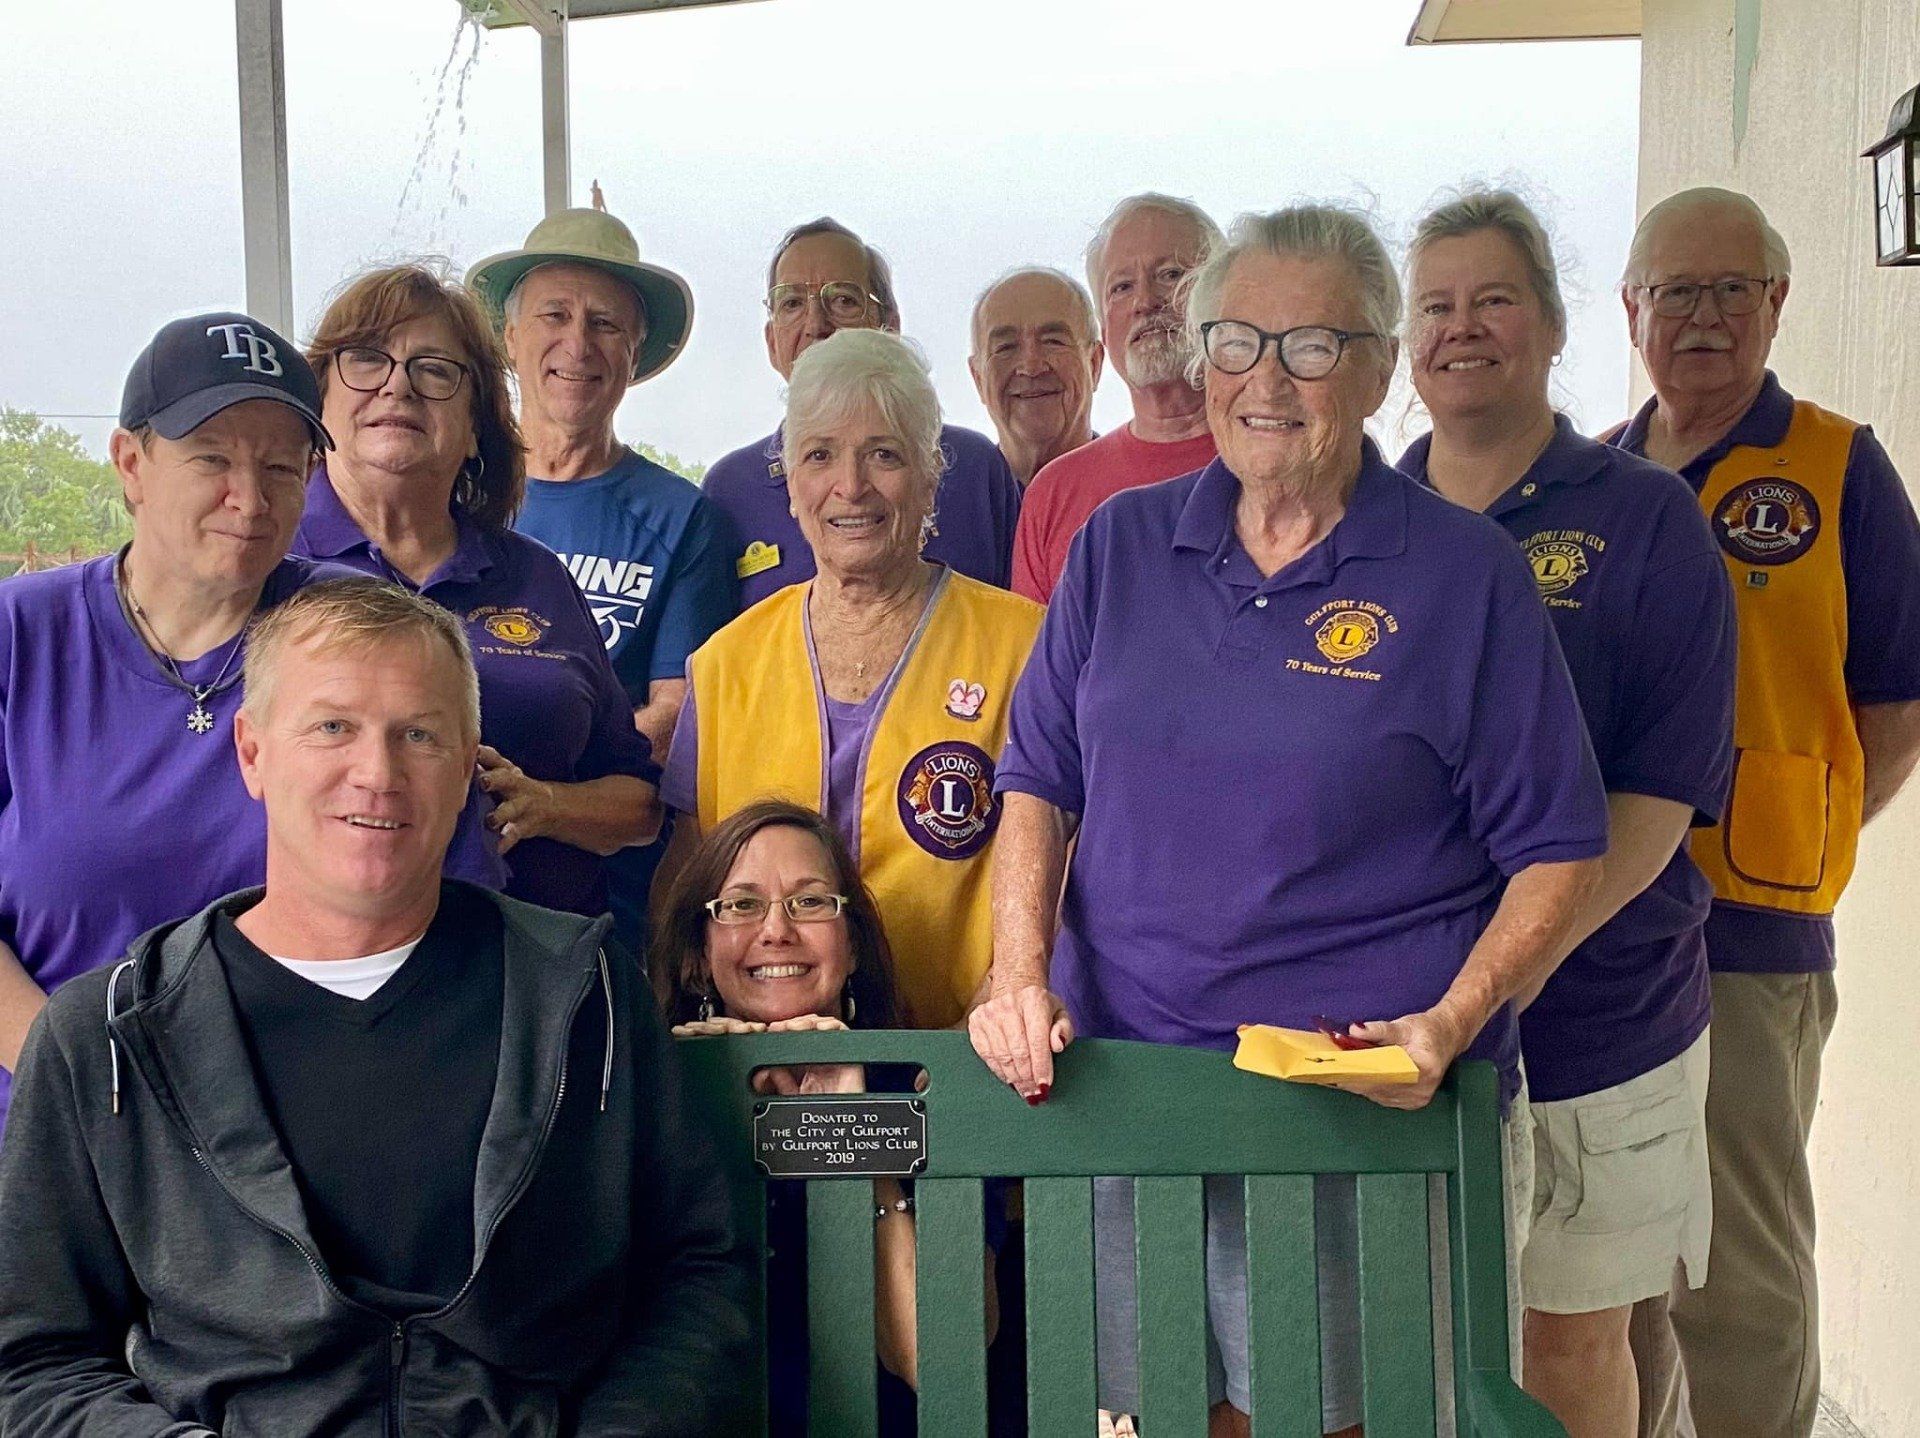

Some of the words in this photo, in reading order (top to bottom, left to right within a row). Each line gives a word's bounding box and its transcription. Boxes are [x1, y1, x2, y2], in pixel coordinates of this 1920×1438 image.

[206, 323, 283, 377] TB
[1749, 487, 1795, 503] LIONS
[1752, 504, 1778, 533] L
[1559, 530, 1584, 543] LIONS
[1534, 545, 1577, 556] LIONS
[1541, 559, 1559, 576] L
[1305, 600, 1355, 625] GULFPORT
[1358, 601, 1386, 616] LIONS
[1337, 627, 1354, 646] L
[496, 646, 521, 655] Years
[1286, 660, 1300, 669] 70
[1302, 662, 1328, 675] Years
[1330, 667, 1341, 676] of
[1343, 668, 1381, 681] Service
[930, 757, 978, 778] LIONS
[940, 780, 965, 818] L
[801, 1112, 856, 1124] DONATED
[863, 1114, 878, 1123] TO
[770, 1128, 791, 1137] THE
[797, 1126, 826, 1137] CITY
[832, 1128, 846, 1137] OF
[852, 1125, 909, 1136] GULFPORT
[762, 1142, 775, 1151] BY
[782, 1140, 839, 1151] GULFPORT
[846, 1139, 880, 1150] LIONS
[885, 1138, 918, 1149] CLUB
[826, 1152, 855, 1164] 2019
